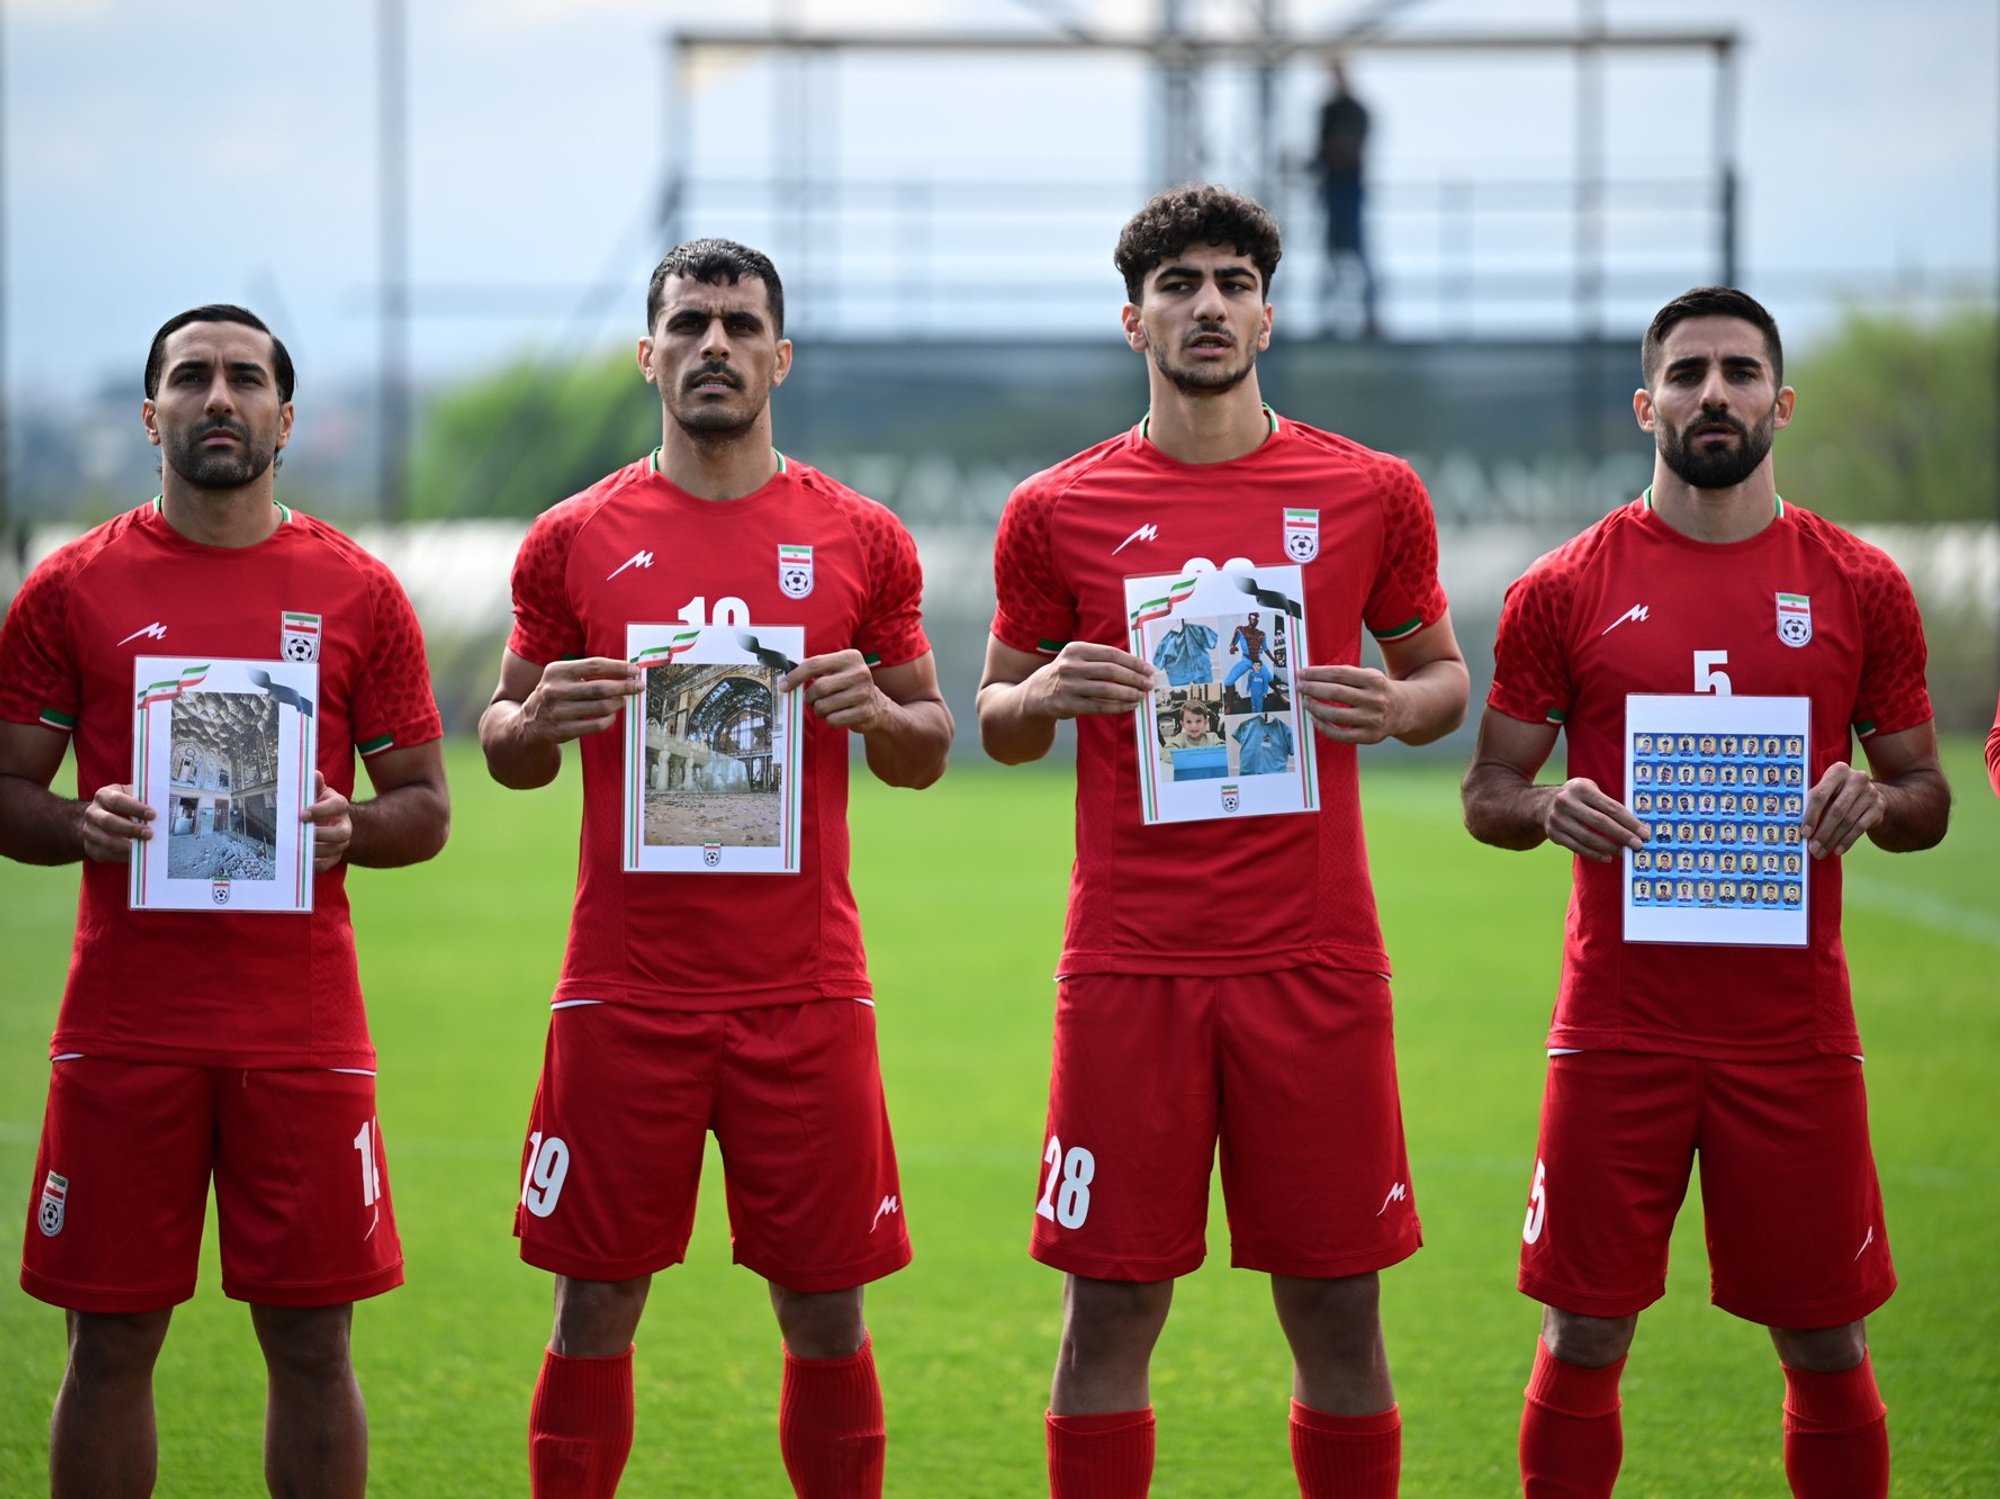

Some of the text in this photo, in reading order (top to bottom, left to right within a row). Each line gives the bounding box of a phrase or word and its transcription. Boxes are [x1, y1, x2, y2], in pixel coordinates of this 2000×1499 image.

[521, 1131, 570, 1218] 19
[1036, 1135, 1095, 1230] 28
[1522, 1157, 1546, 1245] 5
